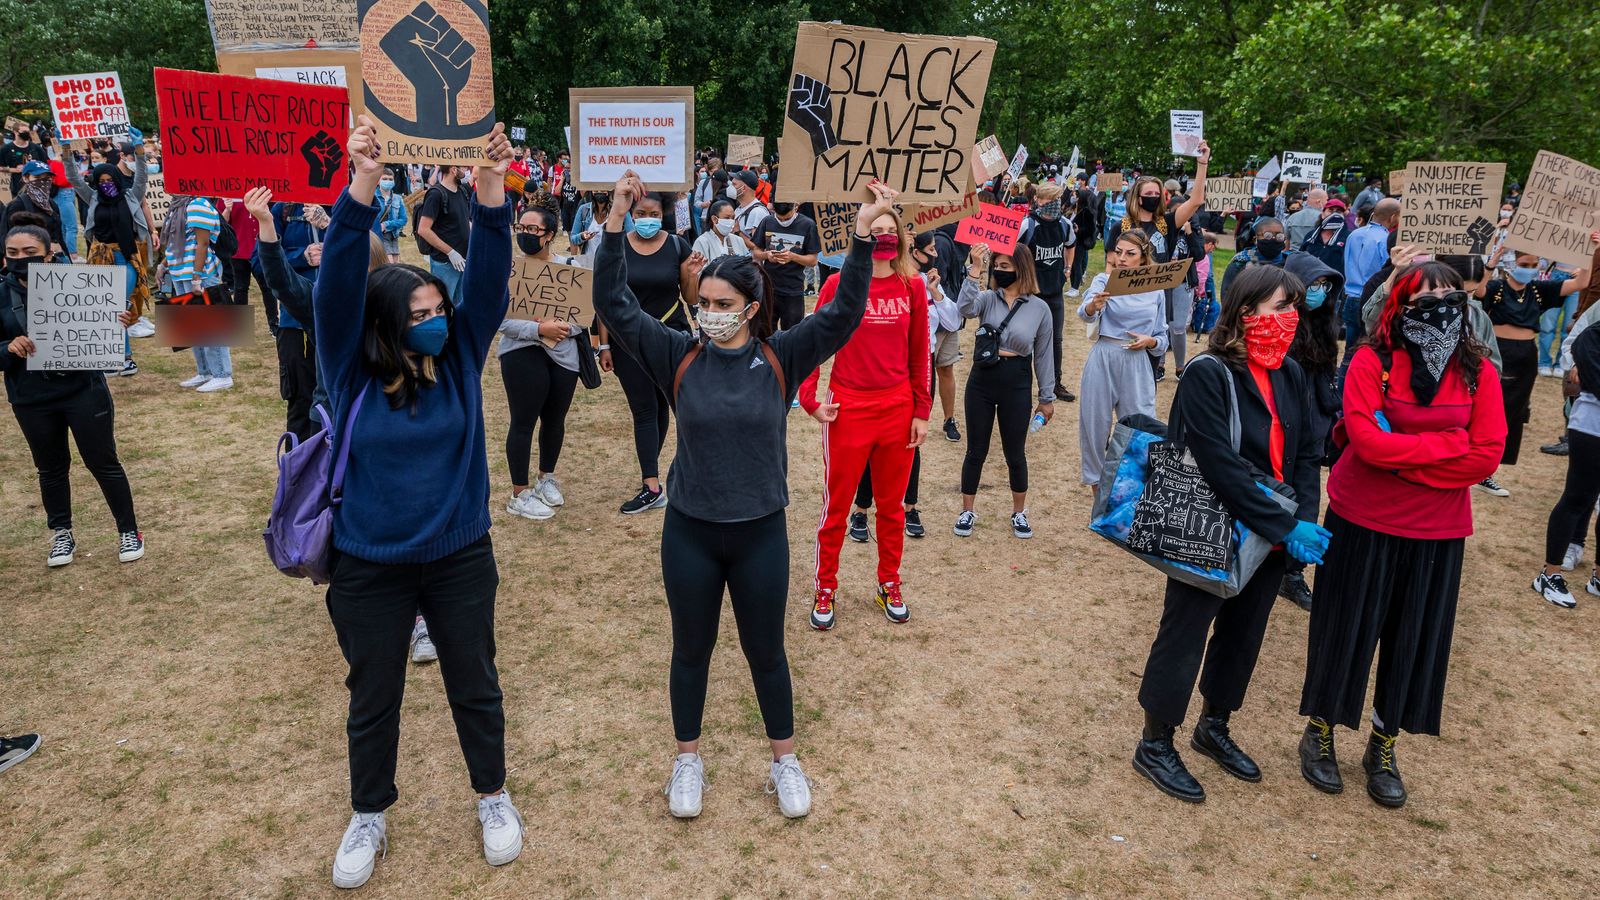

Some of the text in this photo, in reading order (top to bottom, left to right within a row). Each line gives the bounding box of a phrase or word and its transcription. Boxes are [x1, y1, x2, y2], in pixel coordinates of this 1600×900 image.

[297, 70, 337, 85] BLACK
[826, 38, 982, 109] BLACK
[53, 77, 115, 95] WHO DO
[55, 91, 123, 110] WE CALL
[163, 87, 214, 121] THE
[217, 89, 280, 124] LEAST
[288, 96, 350, 130] RACIST
[588, 117, 674, 128] THE TRUTH IS OUR
[836, 97, 963, 149] LIVES
[61, 124, 73, 139] R
[73, 123, 98, 138] THE
[168, 125, 297, 157] IS STILL RACIST
[588, 136, 666, 146] PRIME MINISTER
[387, 141, 485, 160] BLACK LIVES MATTER
[588, 155, 666, 165] IS A REAL RACIST
[1284, 152, 1324, 166] PANTHER
[811, 148, 964, 194] MATTER
[1415, 165, 1486, 181] INJUSTICE
[1538, 153, 1600, 187] THERE COMES
[179, 178, 206, 193] BLACK
[213, 177, 241, 192] LIVES
[1206, 179, 1221, 194] NO
[1222, 178, 1252, 194] JUSTIC
[1409, 182, 1483, 196] ANYWHERE
[1531, 171, 1600, 208] TIME WHEN
[817, 203, 847, 218] HOW
[1205, 197, 1252, 211] NO PEACE
[1405, 197, 1488, 211] IS A THREAT
[1522, 191, 1595, 230] SILENCE IS
[986, 213, 1019, 230] JUSTICE
[1402, 214, 1468, 227] TO JUSTICE
[823, 227, 841, 240] OF
[969, 225, 1010, 245] NO PEACE
[1401, 230, 1473, 246] EVERYWHERE
[1512, 213, 1594, 257] BETRAYAL
[1035, 243, 1064, 261] EVERLAST
[510, 260, 585, 289] BLACK
[1119, 261, 1185, 279] BLACK LIVES
[35, 270, 113, 290] MY SKIN
[1128, 274, 1172, 288] MATTER
[516, 280, 568, 302] IVES
[54, 293, 117, 307] COLOUR
[866, 296, 911, 315] AMN
[509, 297, 580, 323] MATTER
[53, 329, 64, 342] A
[68, 329, 122, 342] DEATH
[52, 344, 124, 359] SENTENCE
[1166, 459, 1181, 469] TEST
[1165, 470, 1192, 484] VERSION
